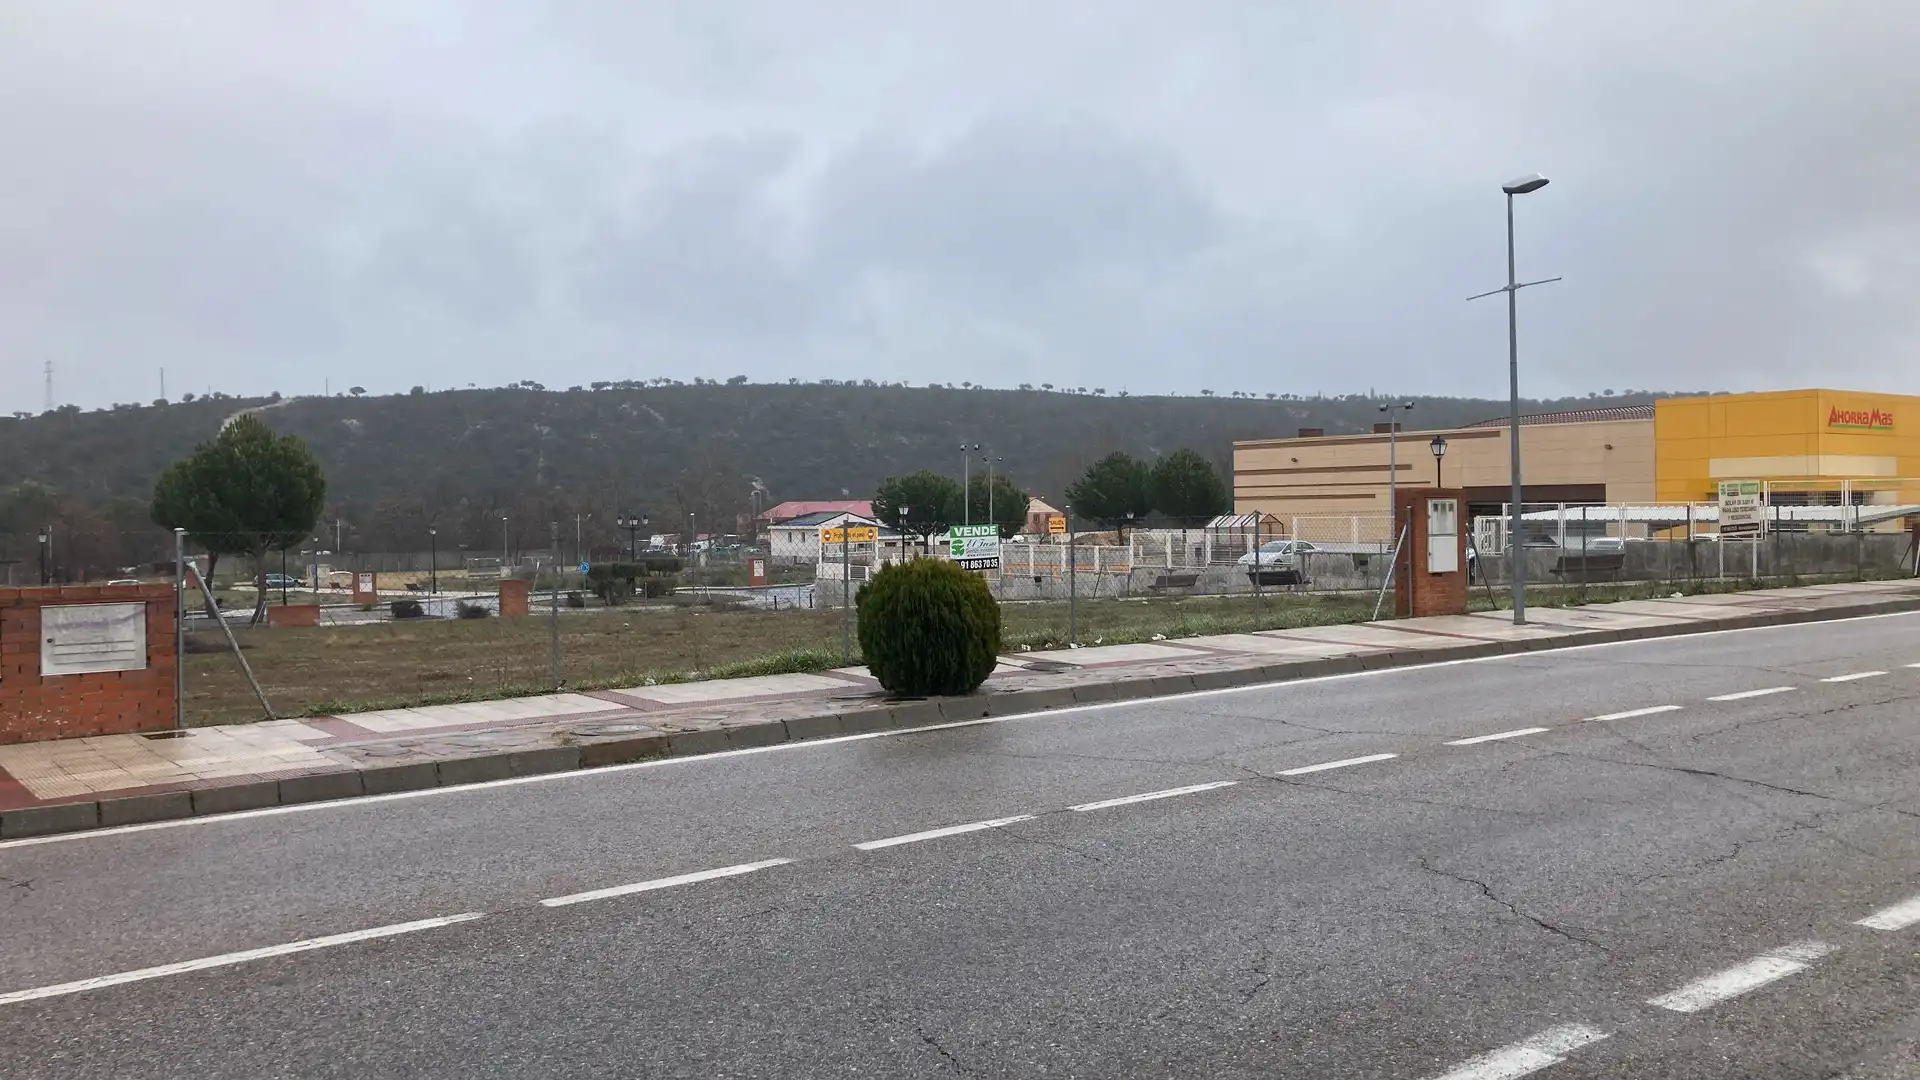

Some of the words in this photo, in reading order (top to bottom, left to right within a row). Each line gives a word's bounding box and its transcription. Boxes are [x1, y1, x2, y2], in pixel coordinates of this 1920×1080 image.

[954, 525, 997, 536] VENDE
[960, 561, 969, 569] 91
[970, 560, 982, 569] 863
[983, 559, 991, 568] 70
[991, 559, 998, 567] 35
